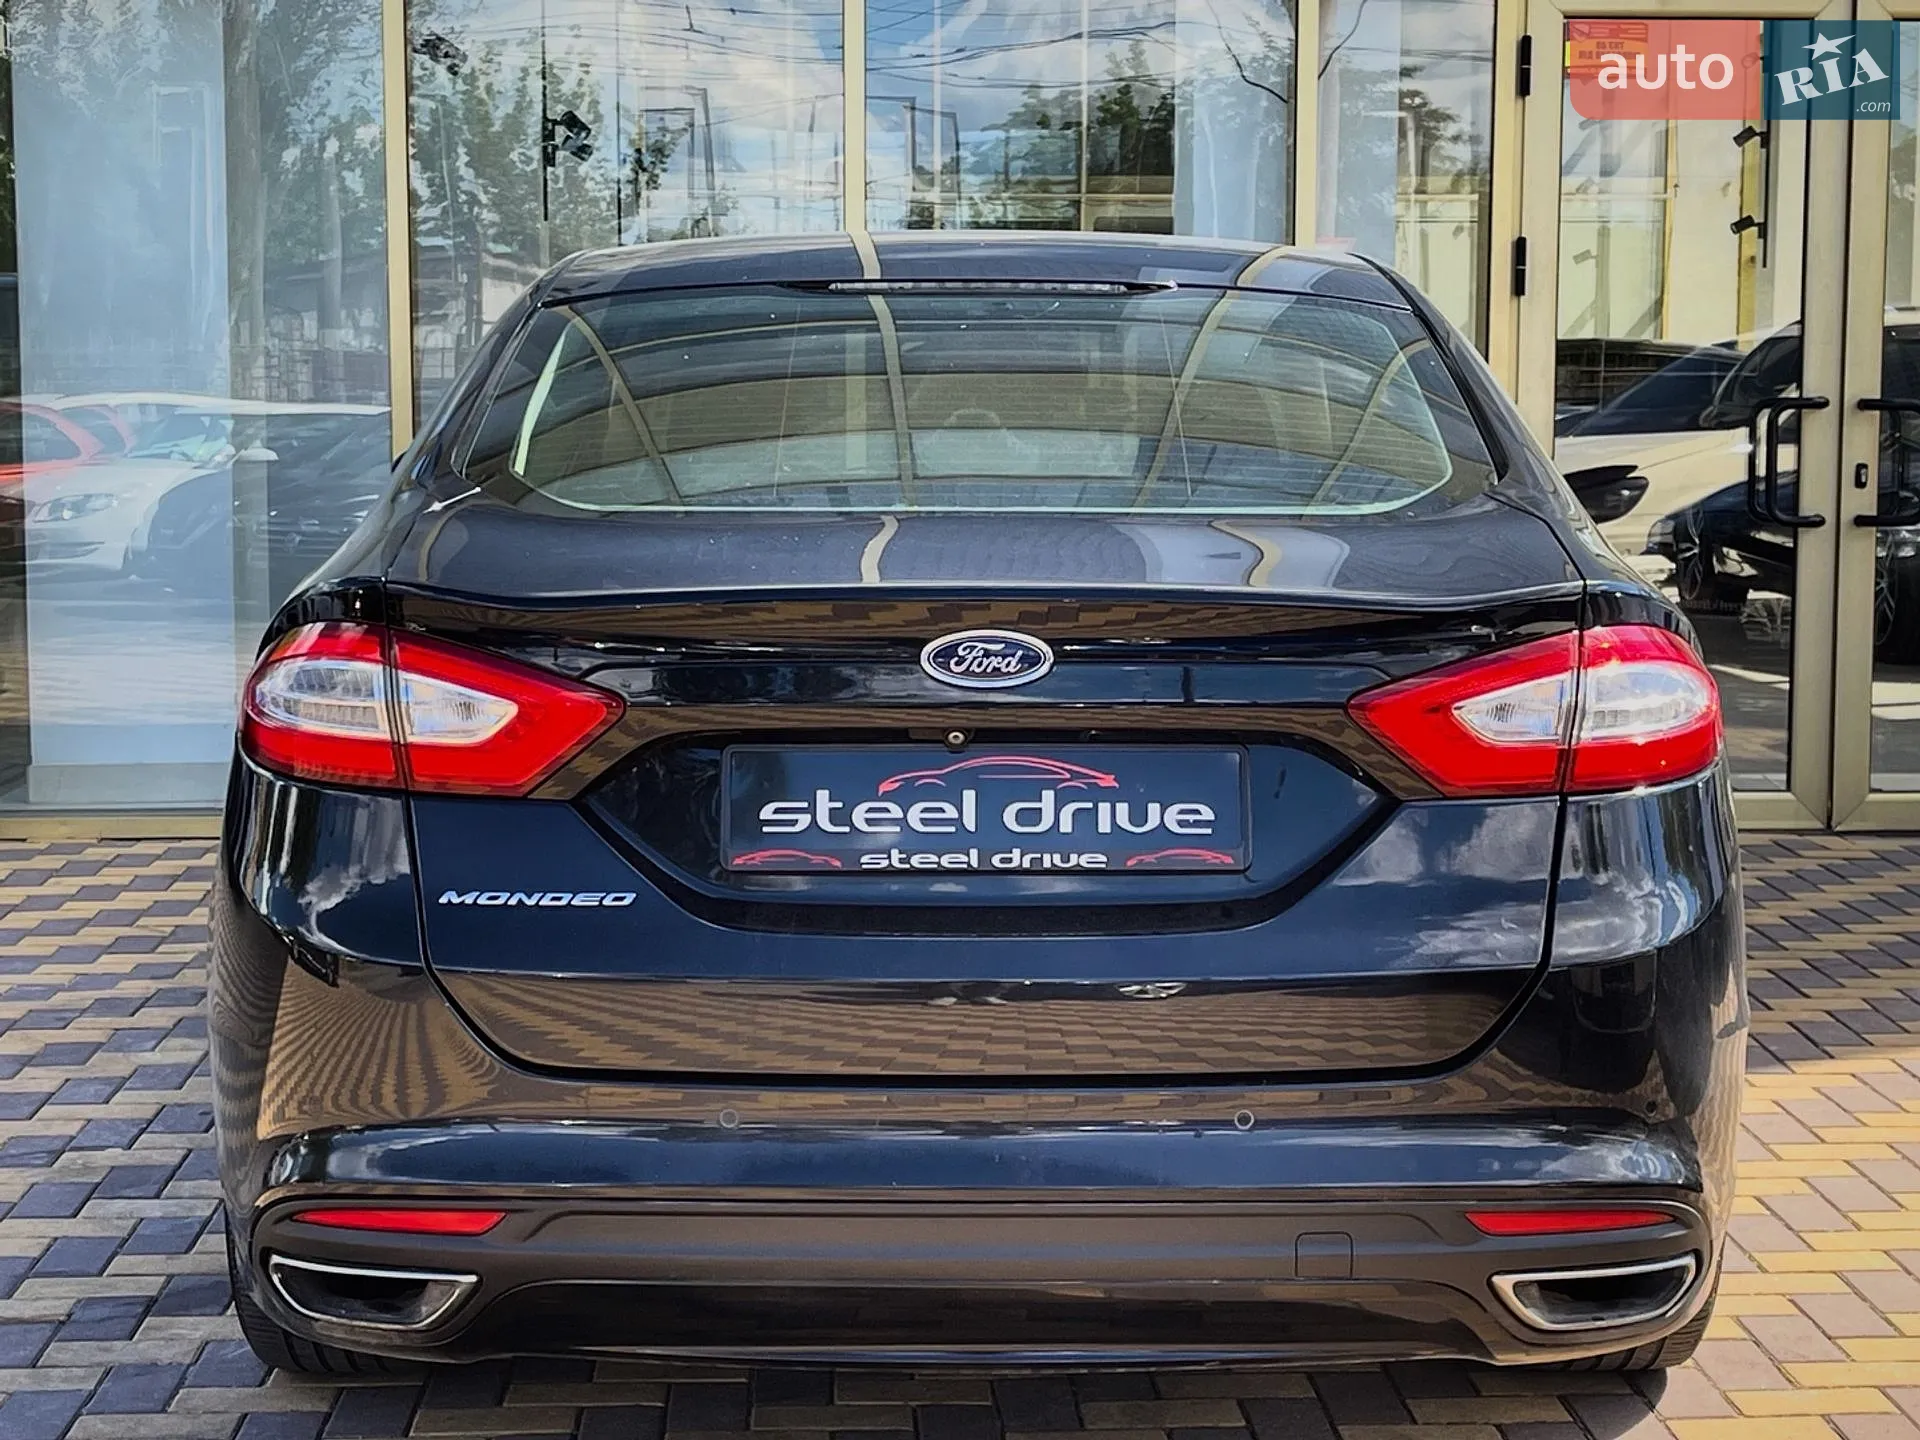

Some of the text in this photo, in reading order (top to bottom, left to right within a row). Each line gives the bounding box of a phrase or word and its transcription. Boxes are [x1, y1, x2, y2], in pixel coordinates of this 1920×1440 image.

[950, 642, 1022, 673] Ford
[759, 789, 1216, 834] steel drive
[860, 848, 1109, 869] steel drive
[438, 891, 637, 906] MONDEO
